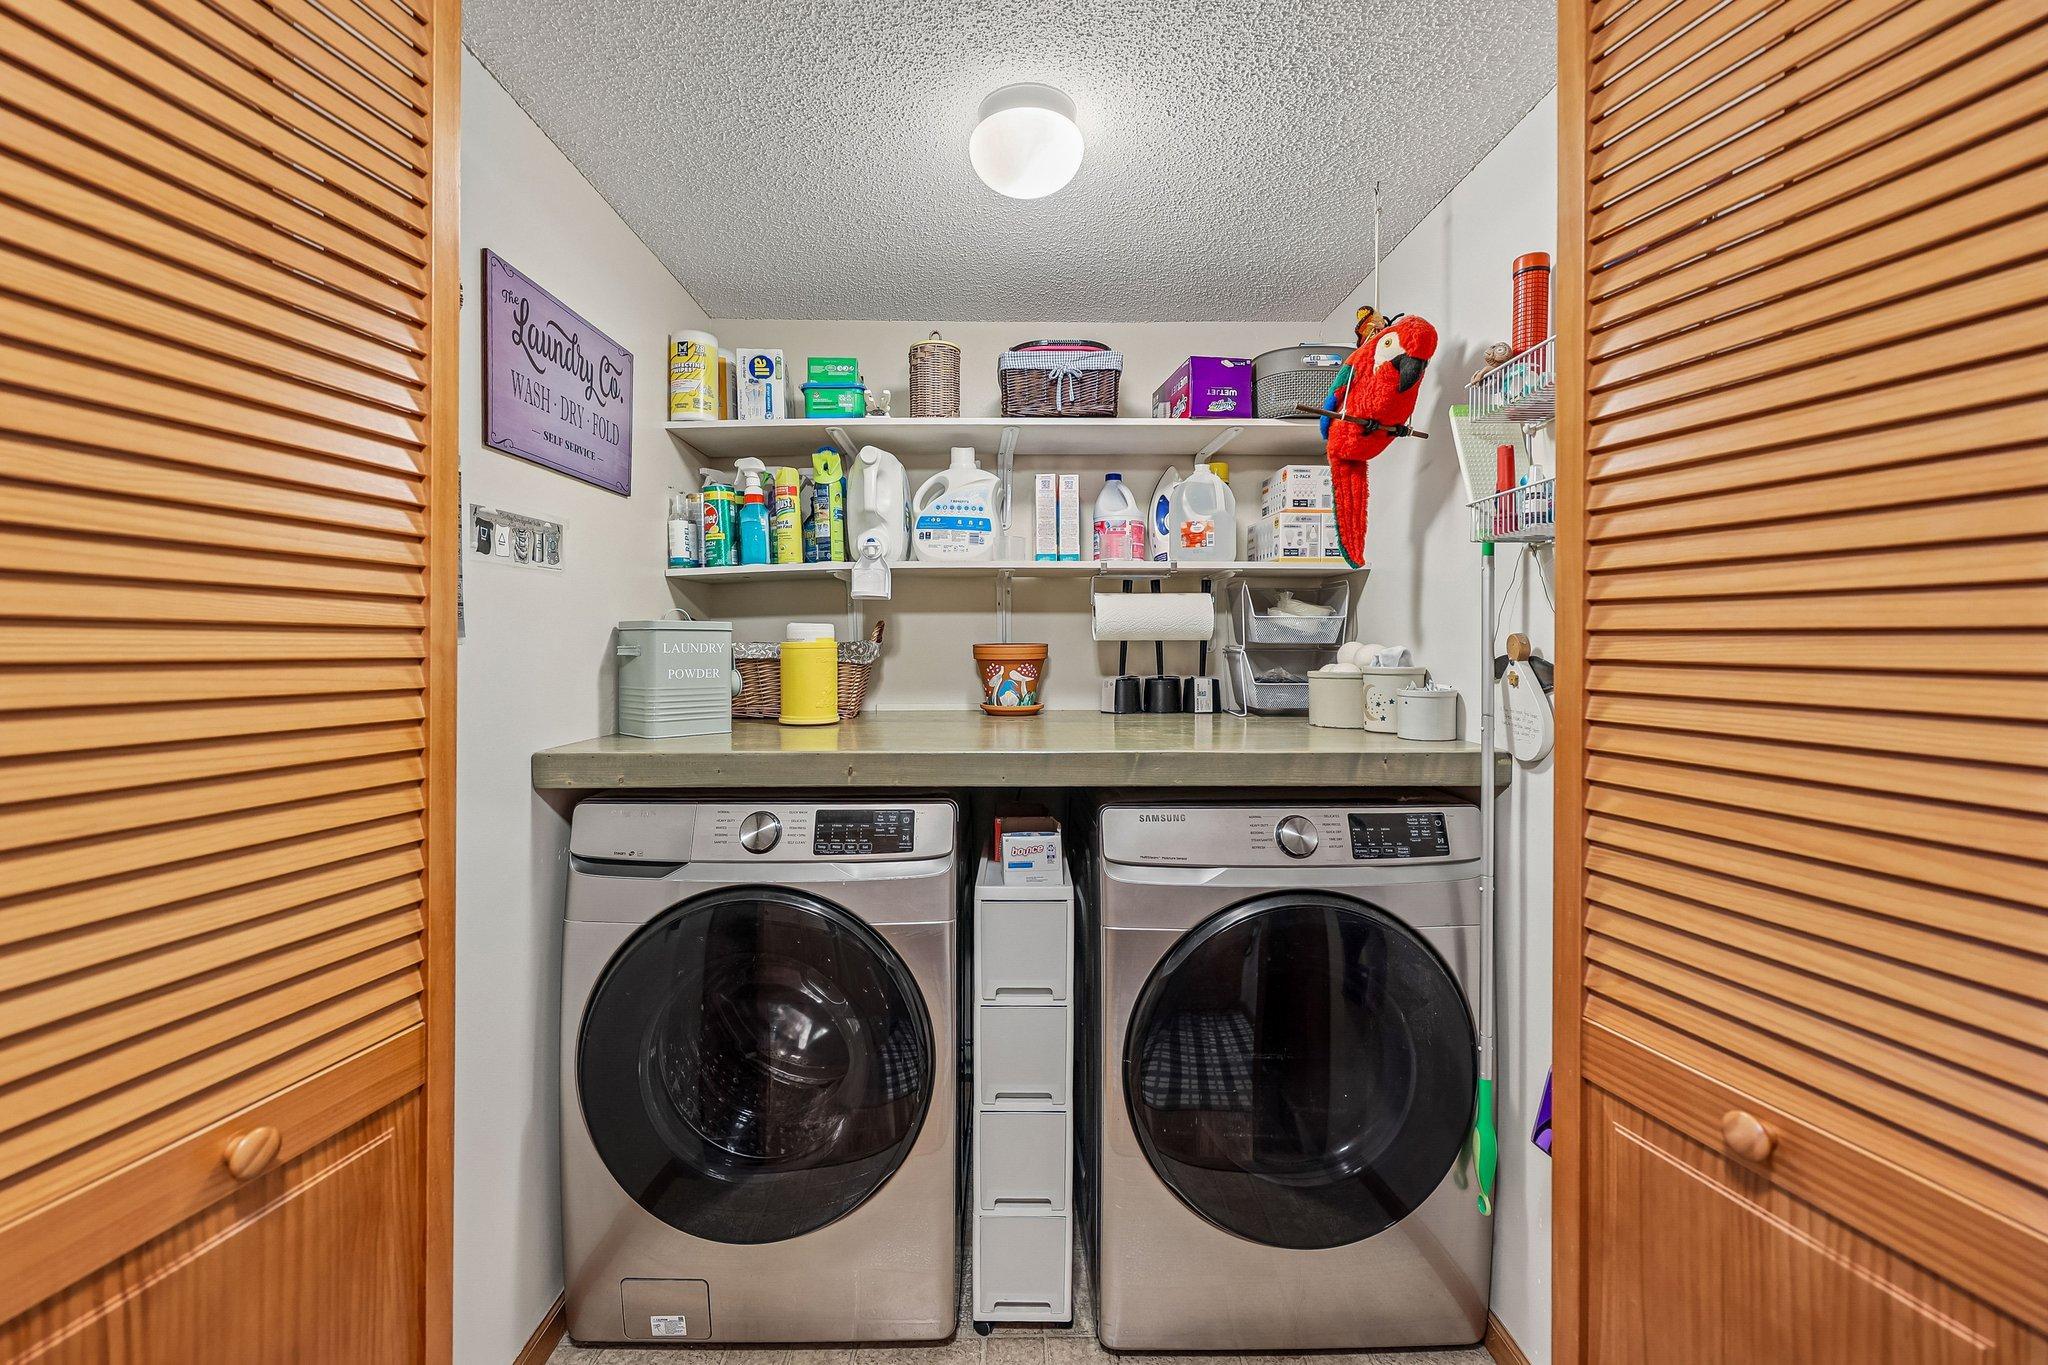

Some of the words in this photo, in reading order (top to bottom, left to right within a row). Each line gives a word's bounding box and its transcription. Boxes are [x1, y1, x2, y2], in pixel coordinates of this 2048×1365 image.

[501, 288, 519, 306] The
[511, 297, 607, 407] Laundry
[599, 354, 624, 404] Co.
[754, 358, 770, 376] all
[510, 368, 551, 414] WASH
[560, 394, 585, 430] DRY
[592, 411, 620, 446] FOLD
[542, 430, 564, 448] SELF
[564, 439, 596, 462] SERVICE
[663, 642, 725, 654] LAUNDRY
[668, 668, 721, 680] POWDER
[1139, 814, 1186, 822] SAMSUNG
[1011, 844, 1044, 857] bounce
